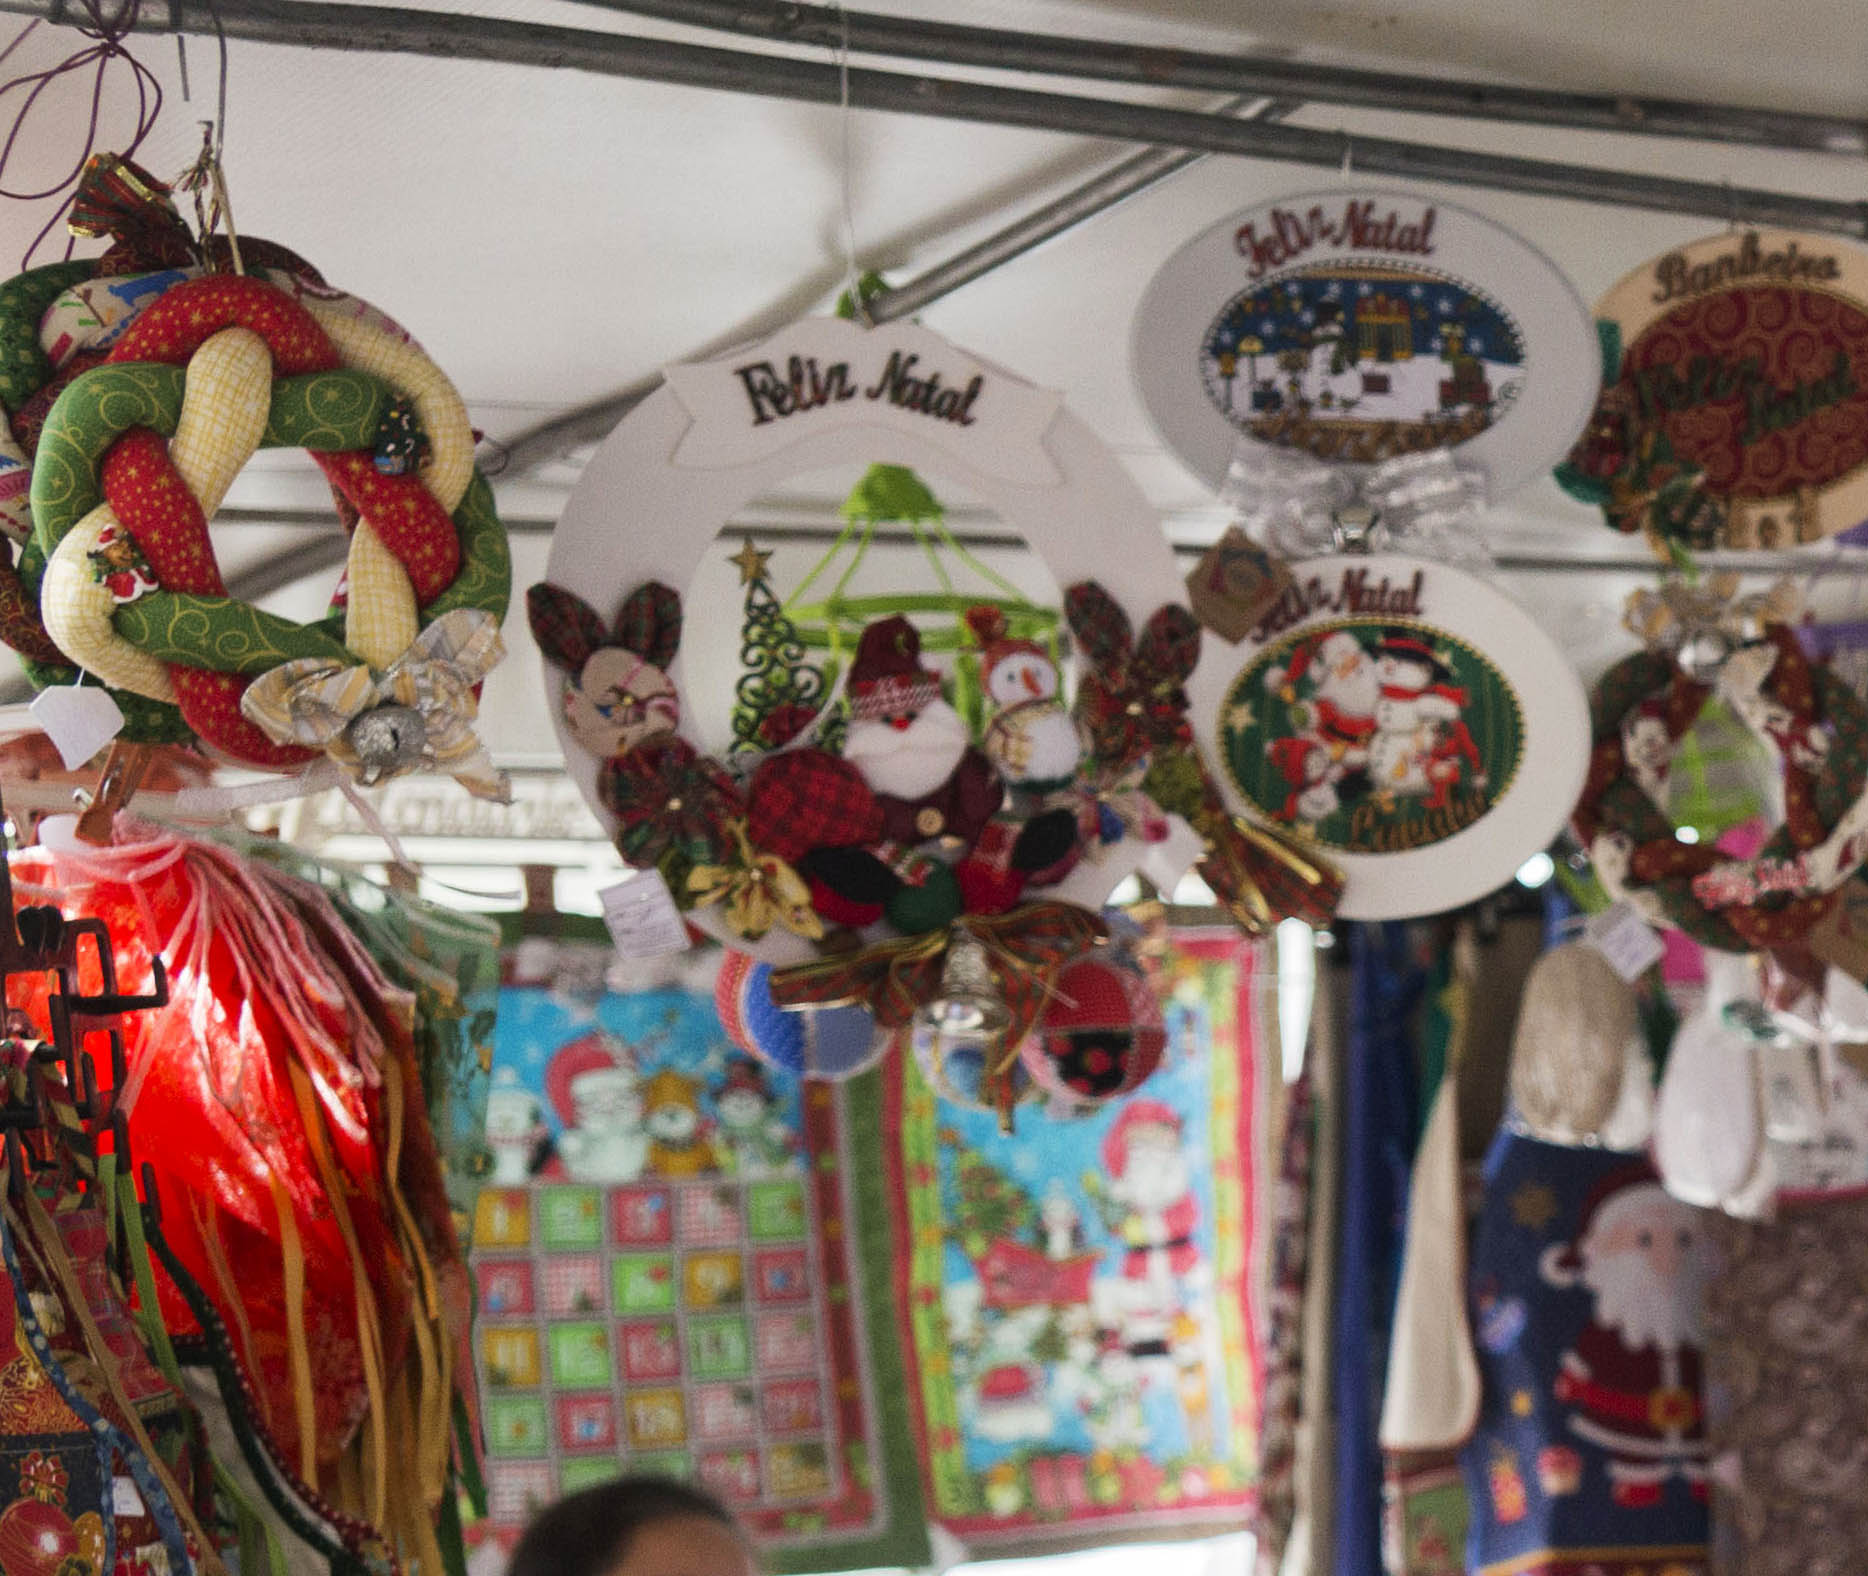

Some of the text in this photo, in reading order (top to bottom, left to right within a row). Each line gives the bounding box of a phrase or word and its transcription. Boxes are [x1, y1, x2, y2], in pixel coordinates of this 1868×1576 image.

[1233, 199, 1437, 278] Feliz Natal
[1652, 230, 1842, 305] Banheiro
[734, 349, 984, 427] Feliz Natal
[1331, 567, 1425, 617] Natal
